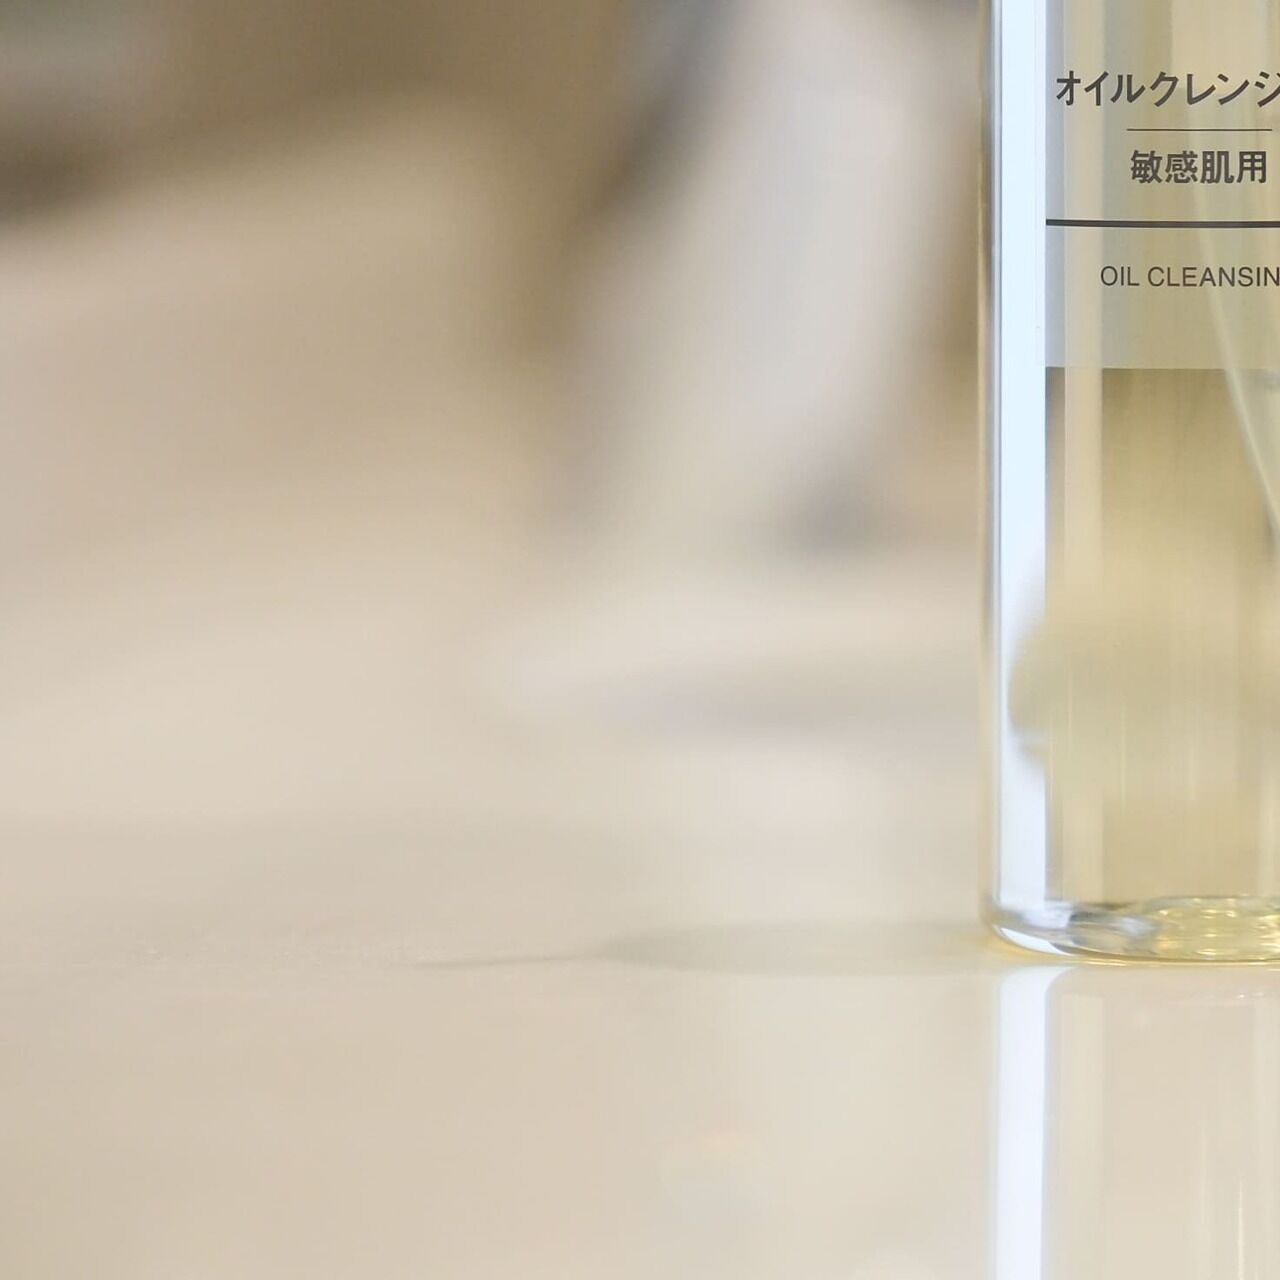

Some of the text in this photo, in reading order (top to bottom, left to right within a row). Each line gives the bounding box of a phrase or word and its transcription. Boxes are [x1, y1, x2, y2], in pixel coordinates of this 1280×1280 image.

[1129, 149, 1268, 184] 敏感肌用
[1100, 265, 1140, 288] OIL
